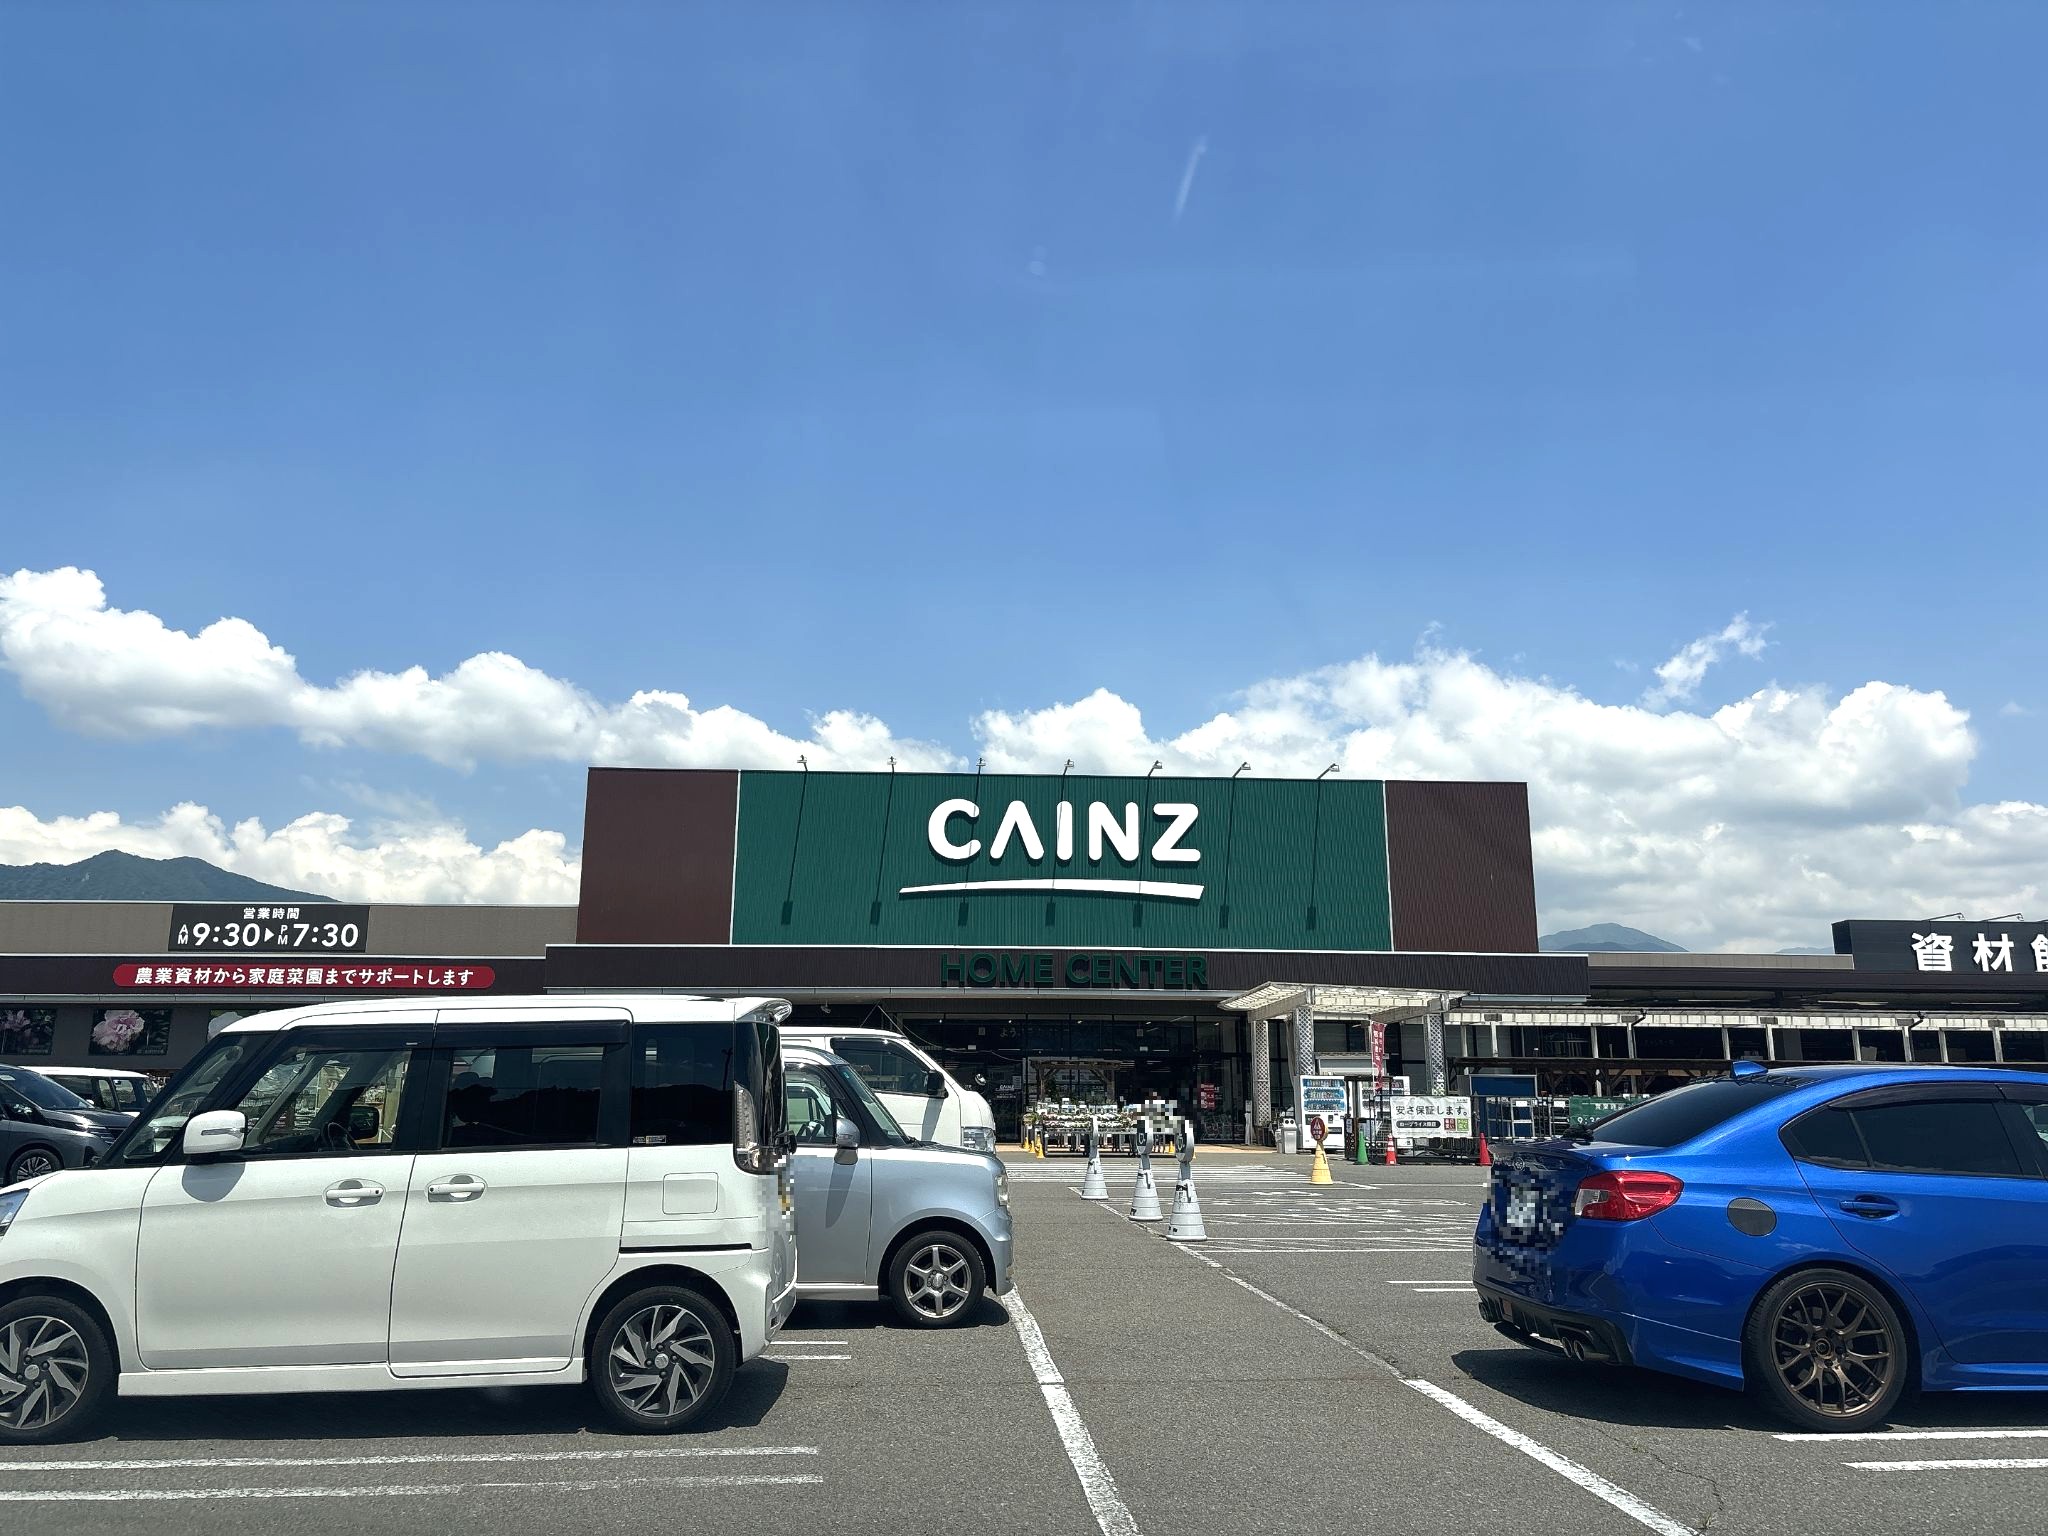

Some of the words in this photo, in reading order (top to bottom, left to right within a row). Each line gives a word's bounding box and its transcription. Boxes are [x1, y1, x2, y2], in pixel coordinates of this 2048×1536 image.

[928, 798, 1201, 862] CAINZ
[243, 907, 301, 920] 営業時間
[178, 924, 188, 946] AM
[193, 923, 260, 947] 9:30
[278, 924, 288, 946] PM
[293, 923, 359, 947] 7:30
[134, 967, 474, 986] 農業資材から家庭菜園までサポートします
[941, 953, 1053, 984] HOME
[1066, 955, 1208, 985] CENTER
[1395, 1105, 1468, 1116] 安さ保証します。
